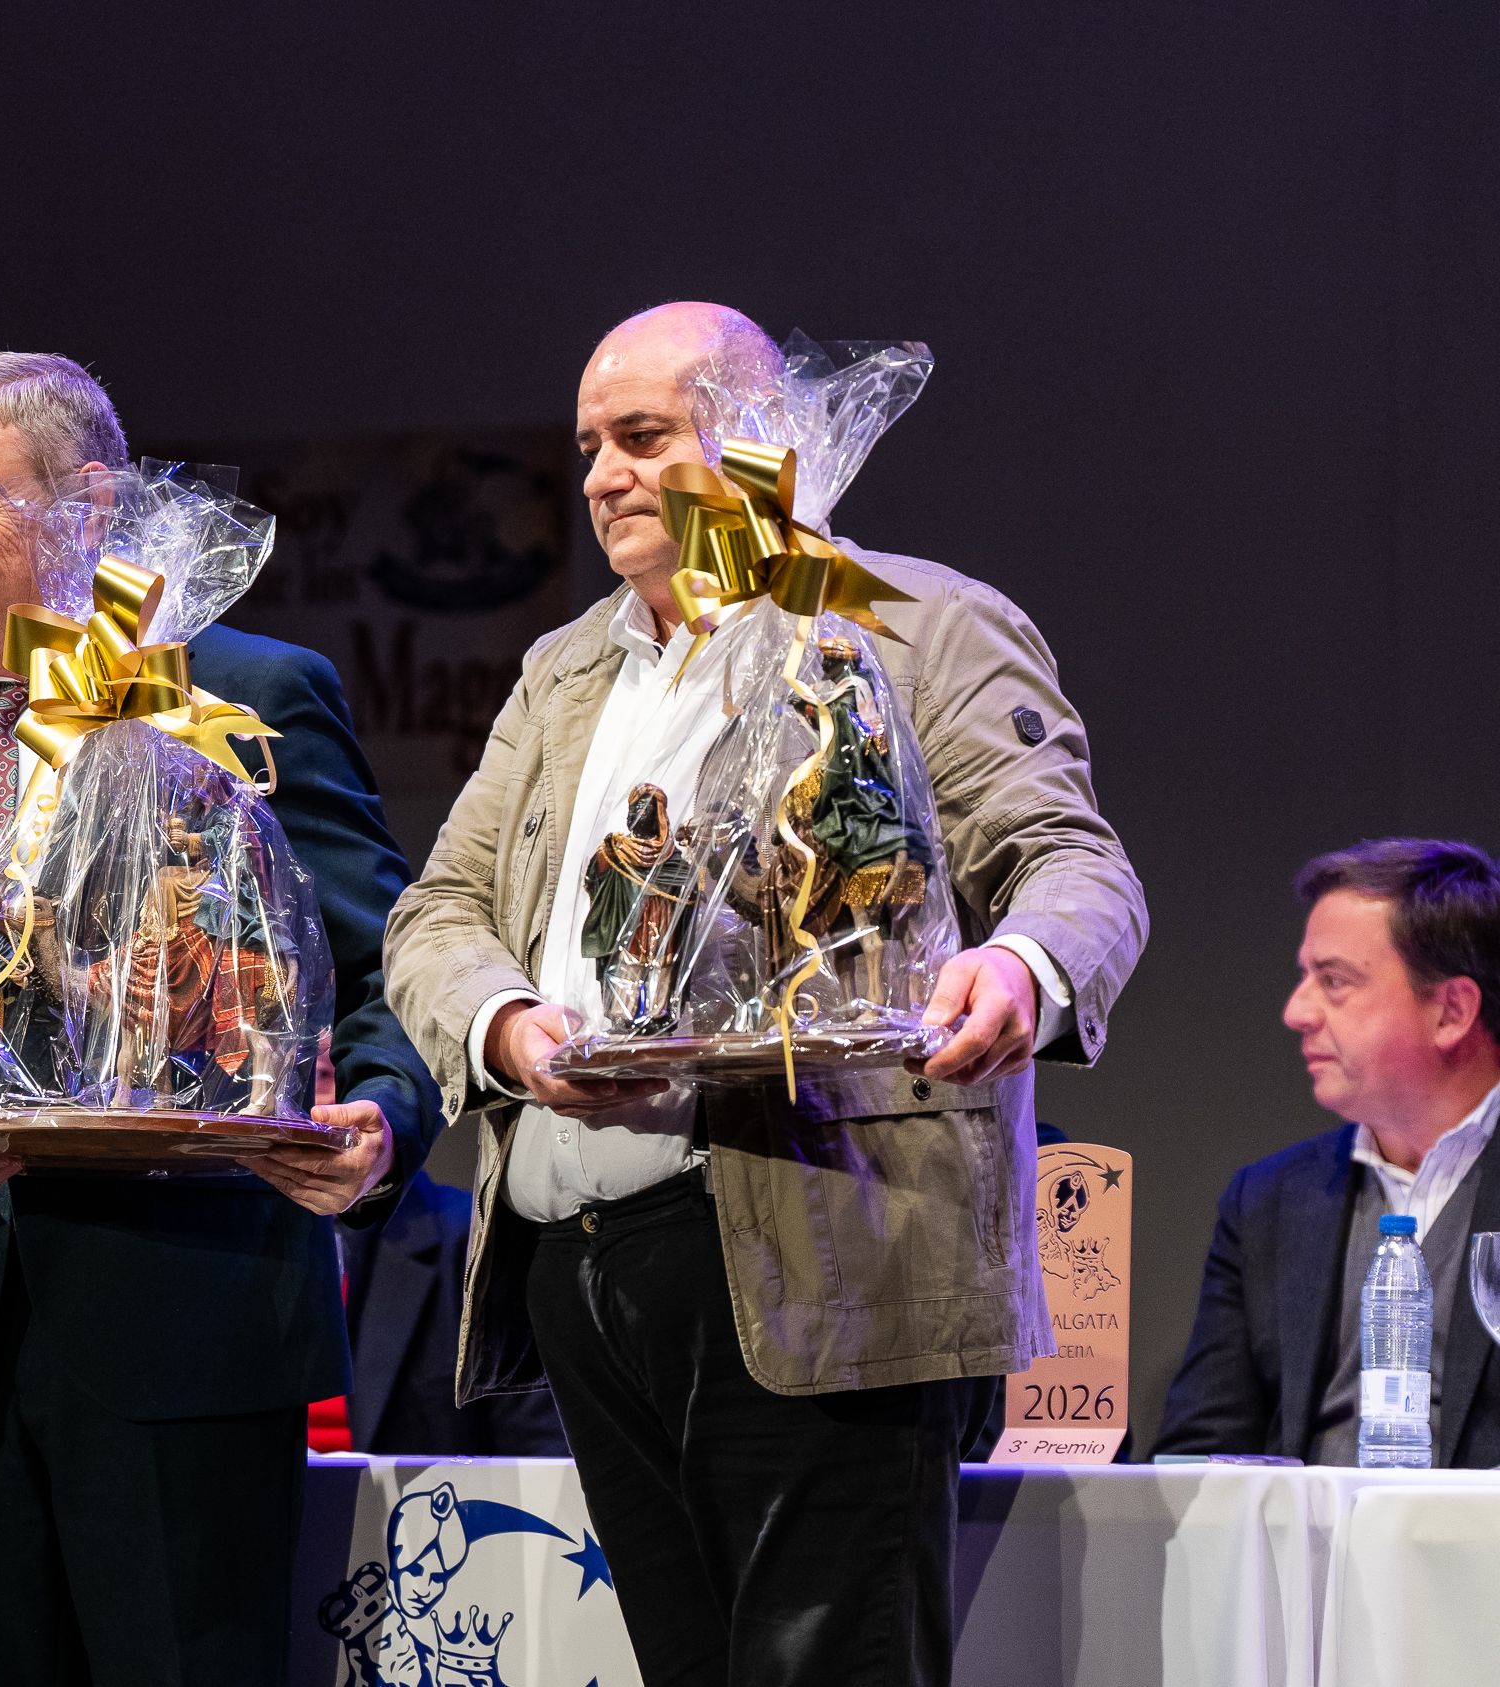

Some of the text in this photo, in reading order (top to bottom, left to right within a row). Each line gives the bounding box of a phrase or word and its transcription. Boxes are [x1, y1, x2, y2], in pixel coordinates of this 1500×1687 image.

[351, 619, 521, 775] Mag
[1051, 1313, 1119, 1330] ALGATA
[1041, 1345, 1094, 1358] CENA
[1023, 1384, 1115, 1420] 2026
[1033, 1440, 1105, 1455] Premio
